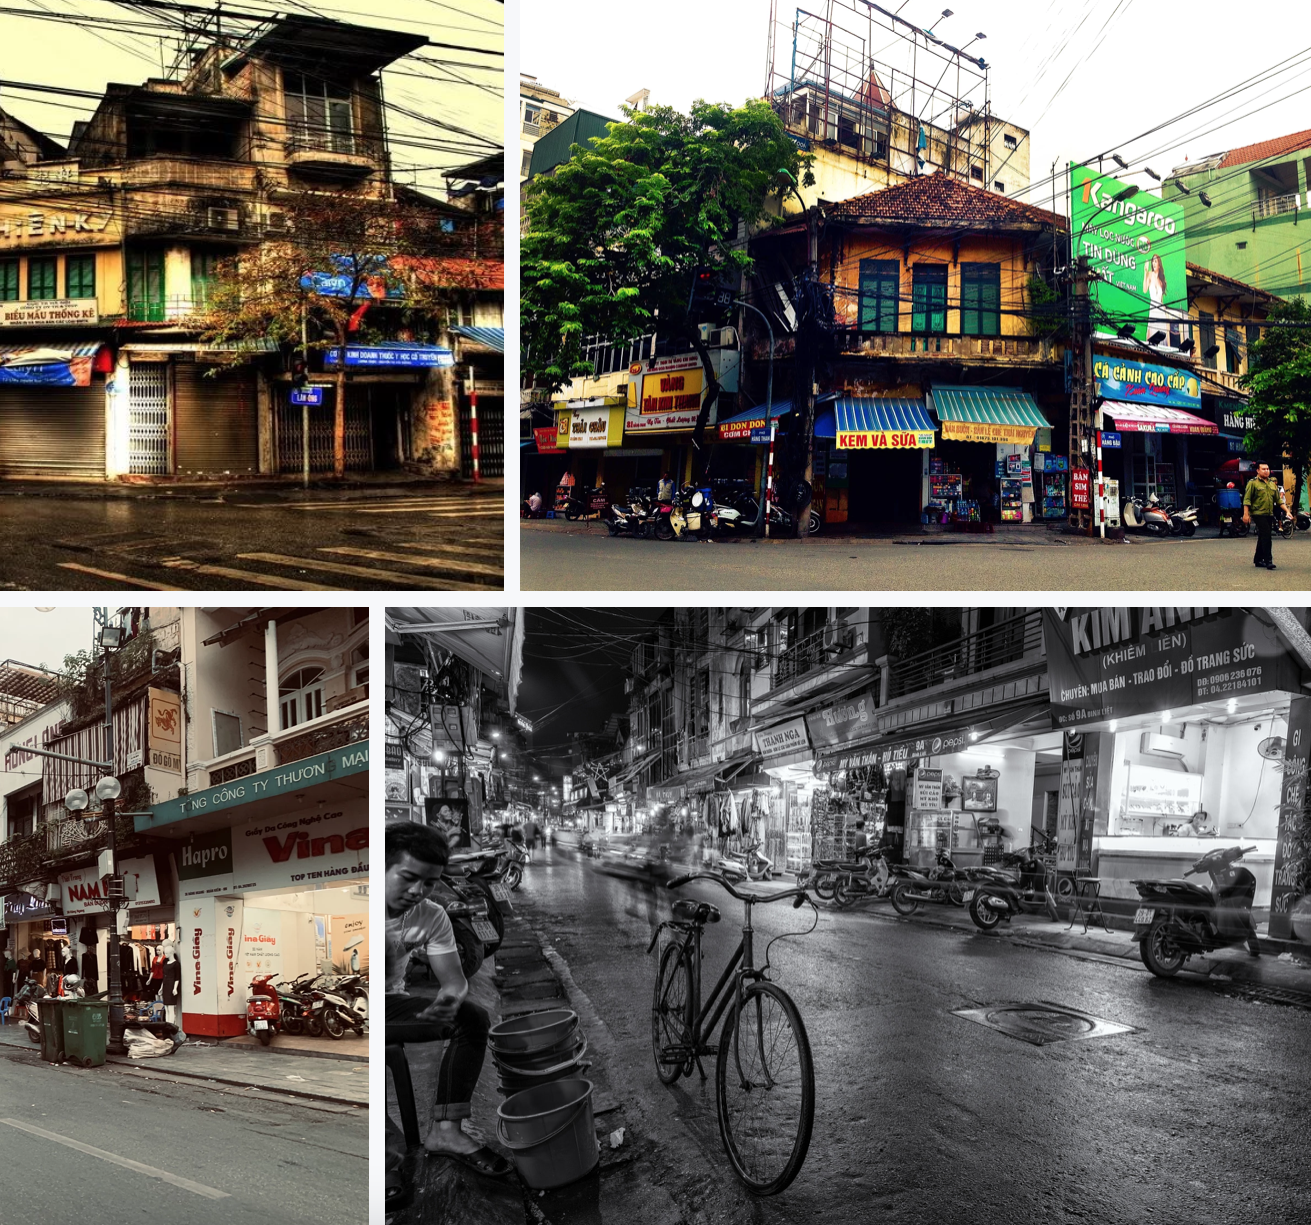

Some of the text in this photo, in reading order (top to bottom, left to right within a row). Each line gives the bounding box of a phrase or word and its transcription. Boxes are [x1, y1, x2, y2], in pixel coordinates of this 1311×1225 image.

[1081, 177, 1176, 235] Kangaroo
[1099, 229, 1114, 241] LỌC
[1115, 232, 1135, 248] NƯỚC
[1105, 245, 1136, 270] DÙNG
[82, 308, 94, 318] KÊ
[1094, 359, 1185, 390] CÁ CẢNH CAO CẤP
[730, 421, 747, 430] DON
[1223, 411, 1244, 429] HÀNG
[839, 435, 868, 447] KEM
[872, 433, 887, 446] VÀ
[892, 433, 917, 446] SỮA
[1074, 471, 1088, 480] BÁN
[1074, 492, 1087, 502] THẺ
[1070, 607, 1132, 656] KIM
[1090, 682, 1108, 694] MUA
[1109, 674, 1126, 691] BÁN
[1133, 670, 1154, 685] TRAO
[1157, 662, 1172, 680] ĐỔI
[1181, 654, 1194, 674] ĐỒ
[1197, 651, 1230, 670] TRANG
[1233, 642, 1256, 662] SỨC
[1076, 709, 1086, 719] 9A
[763, 729, 800, 747] THANH NGA
[943, 736, 966, 749] pepsi
[212, 786, 245, 804] CÔNG
[252, 780, 269, 793] TY
[265, 824, 276, 832] Da
[299, 815, 322, 826] Nghệ
[323, 811, 343, 820] Cao
[262, 827, 369, 863] Vina
[182, 844, 228, 868] Hapro
[291, 873, 306, 882] TOP
[307, 870, 323, 879] TEN
[324, 866, 348, 877] HÀNG
[68, 882, 100, 902] NAM
[193, 962, 202, 996] Vina
[227, 960, 235, 997] Vina
